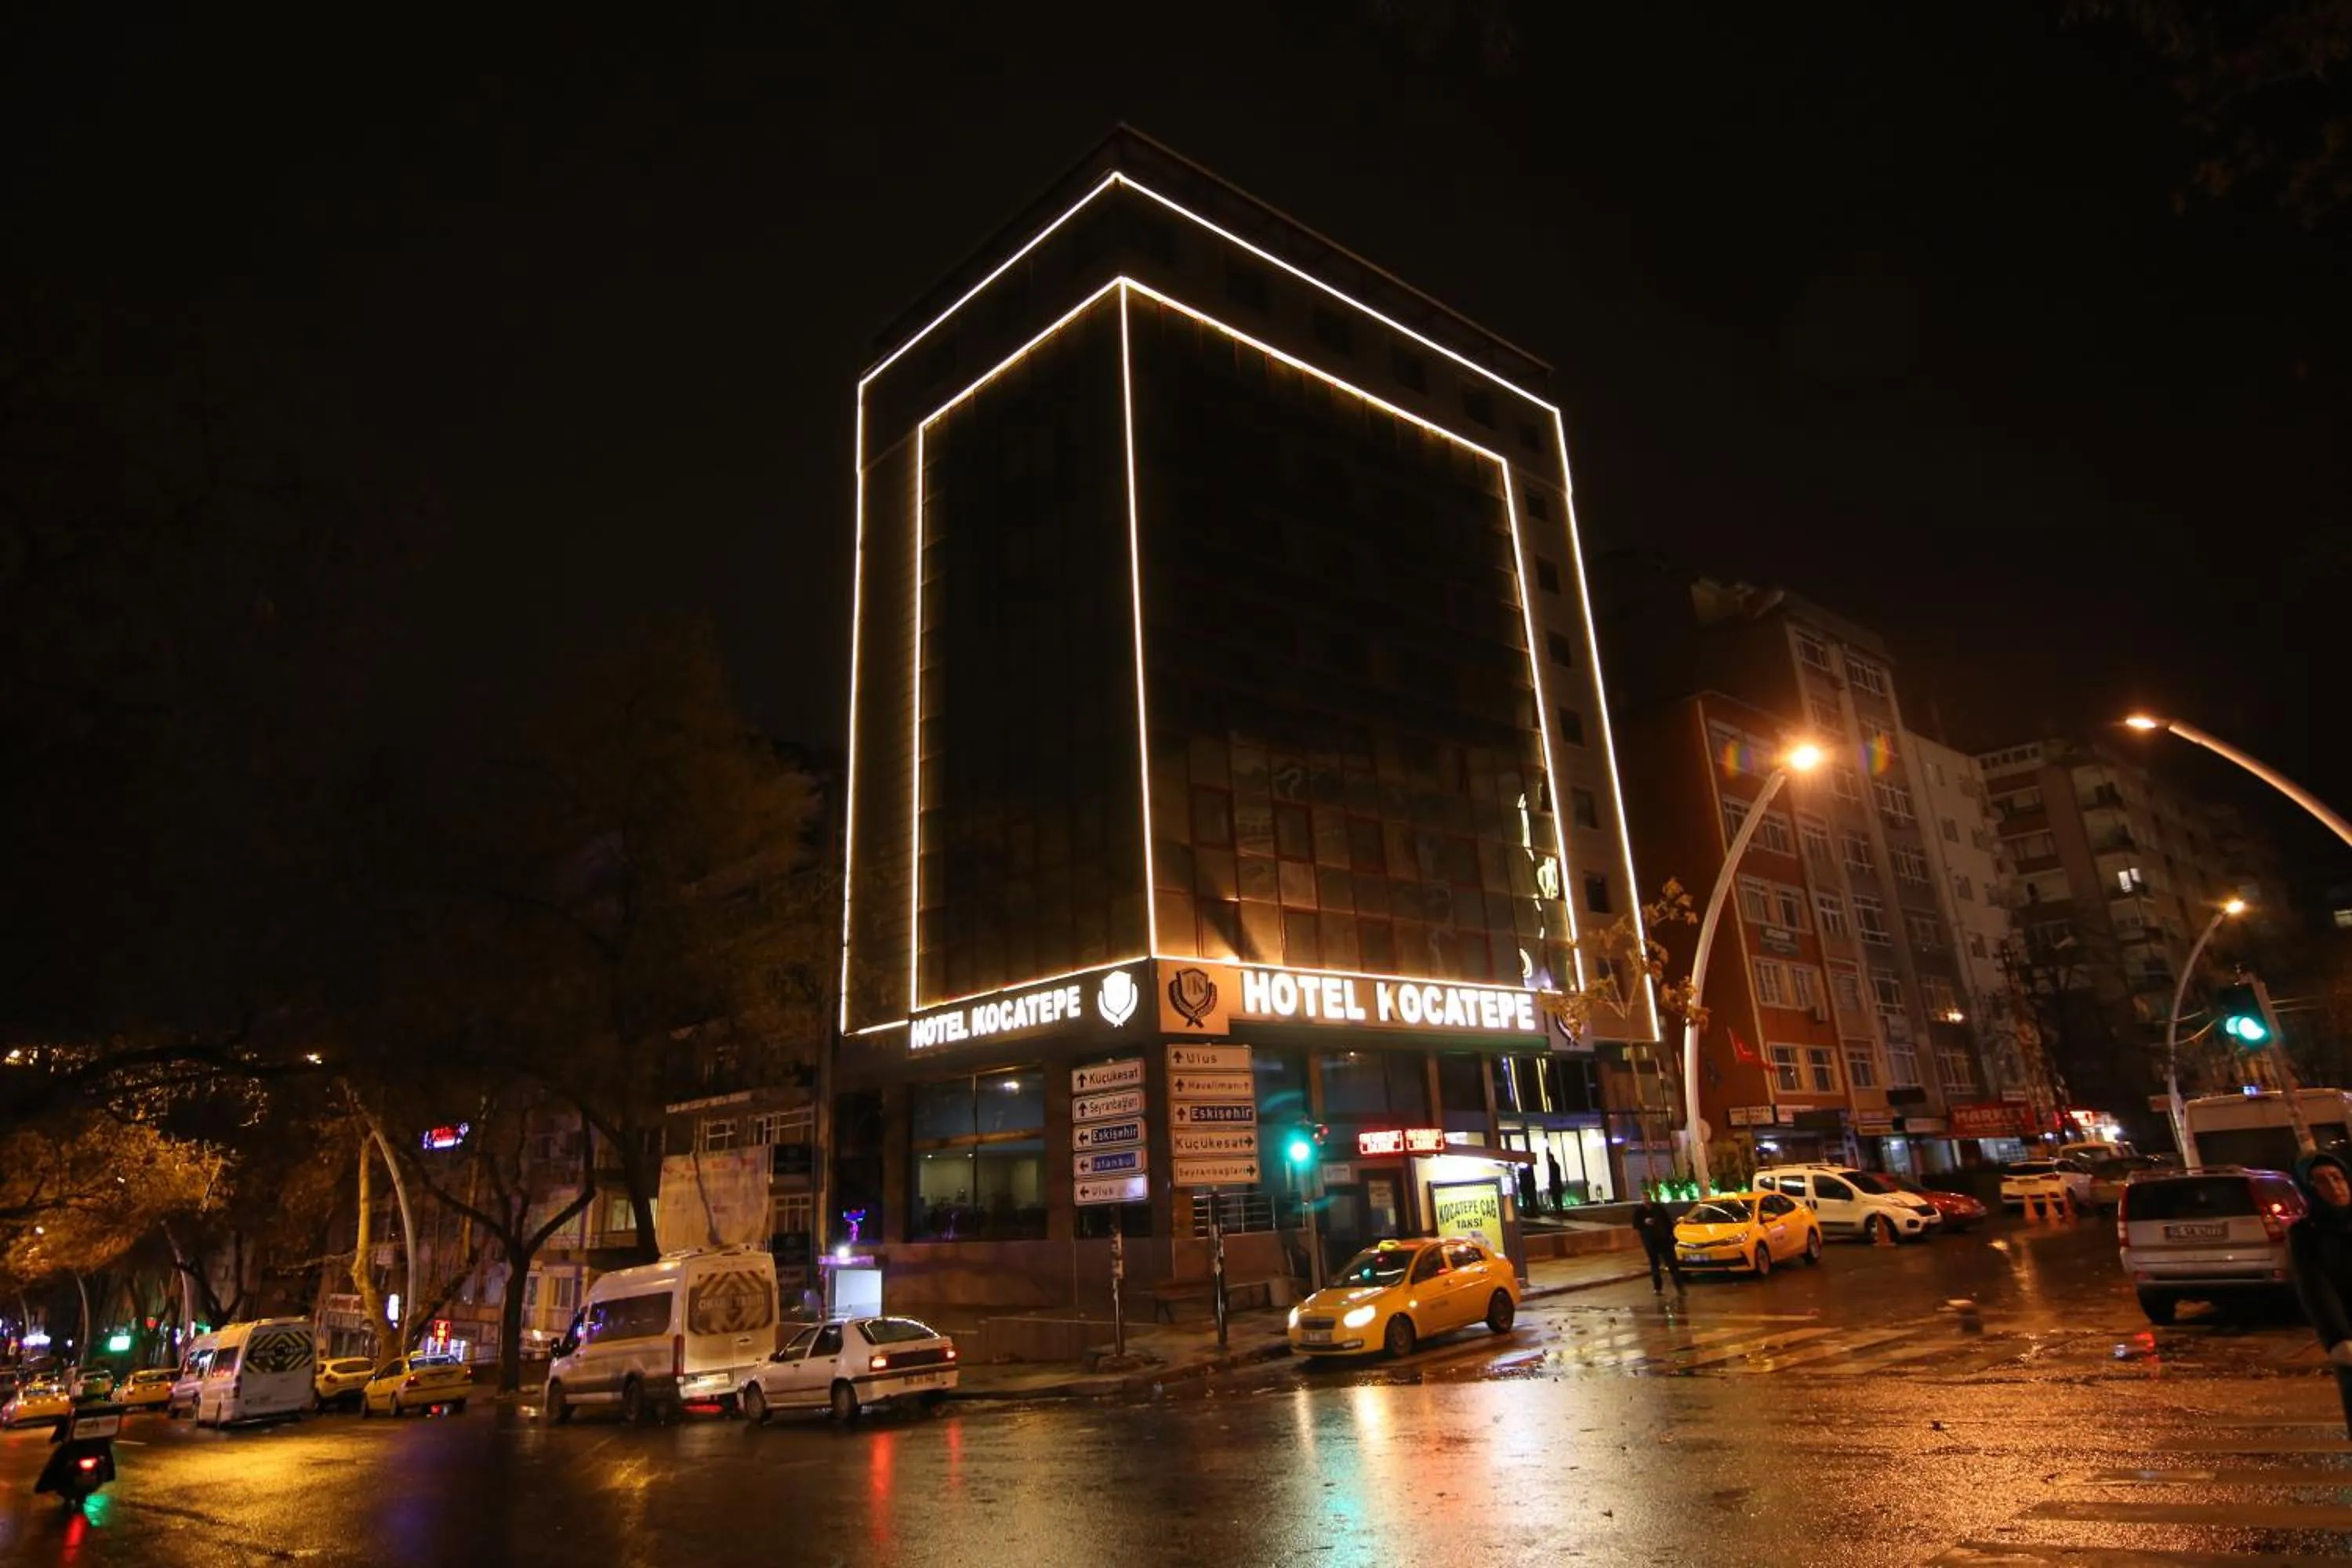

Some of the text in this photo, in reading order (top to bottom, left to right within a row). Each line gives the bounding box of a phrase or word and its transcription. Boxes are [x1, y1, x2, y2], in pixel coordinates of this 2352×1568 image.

[910, 985, 1081, 1049] HOTEL KOCATEPE
[1243, 971, 1535, 1030] HOTEL KOCATEPE
[1186, 1053, 1218, 1064] Ulus
[1954, 1107, 2027, 1123] MARKT
